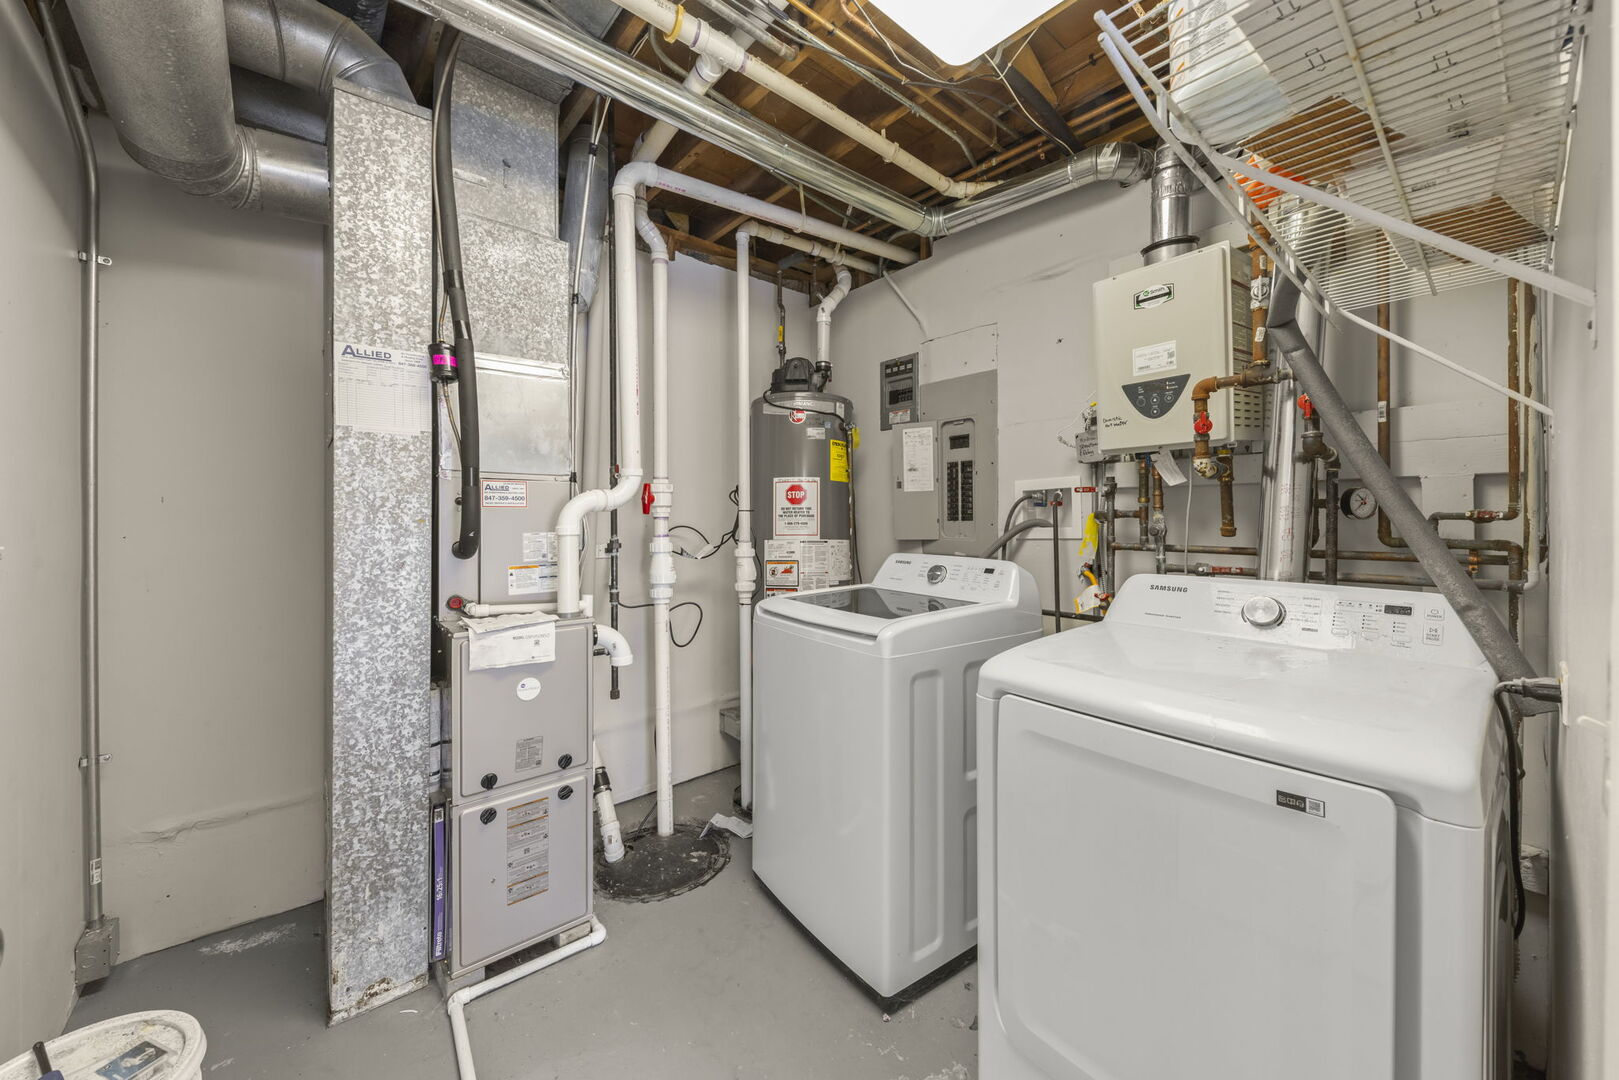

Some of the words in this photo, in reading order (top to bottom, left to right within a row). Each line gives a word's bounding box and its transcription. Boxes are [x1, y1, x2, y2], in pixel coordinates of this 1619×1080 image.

[341, 345, 392, 359] ALLIED
[485, 484, 510, 492] ALLIED
[787, 491, 805, 499] STOP
[1150, 584, 1188, 593] SAMSUNG
